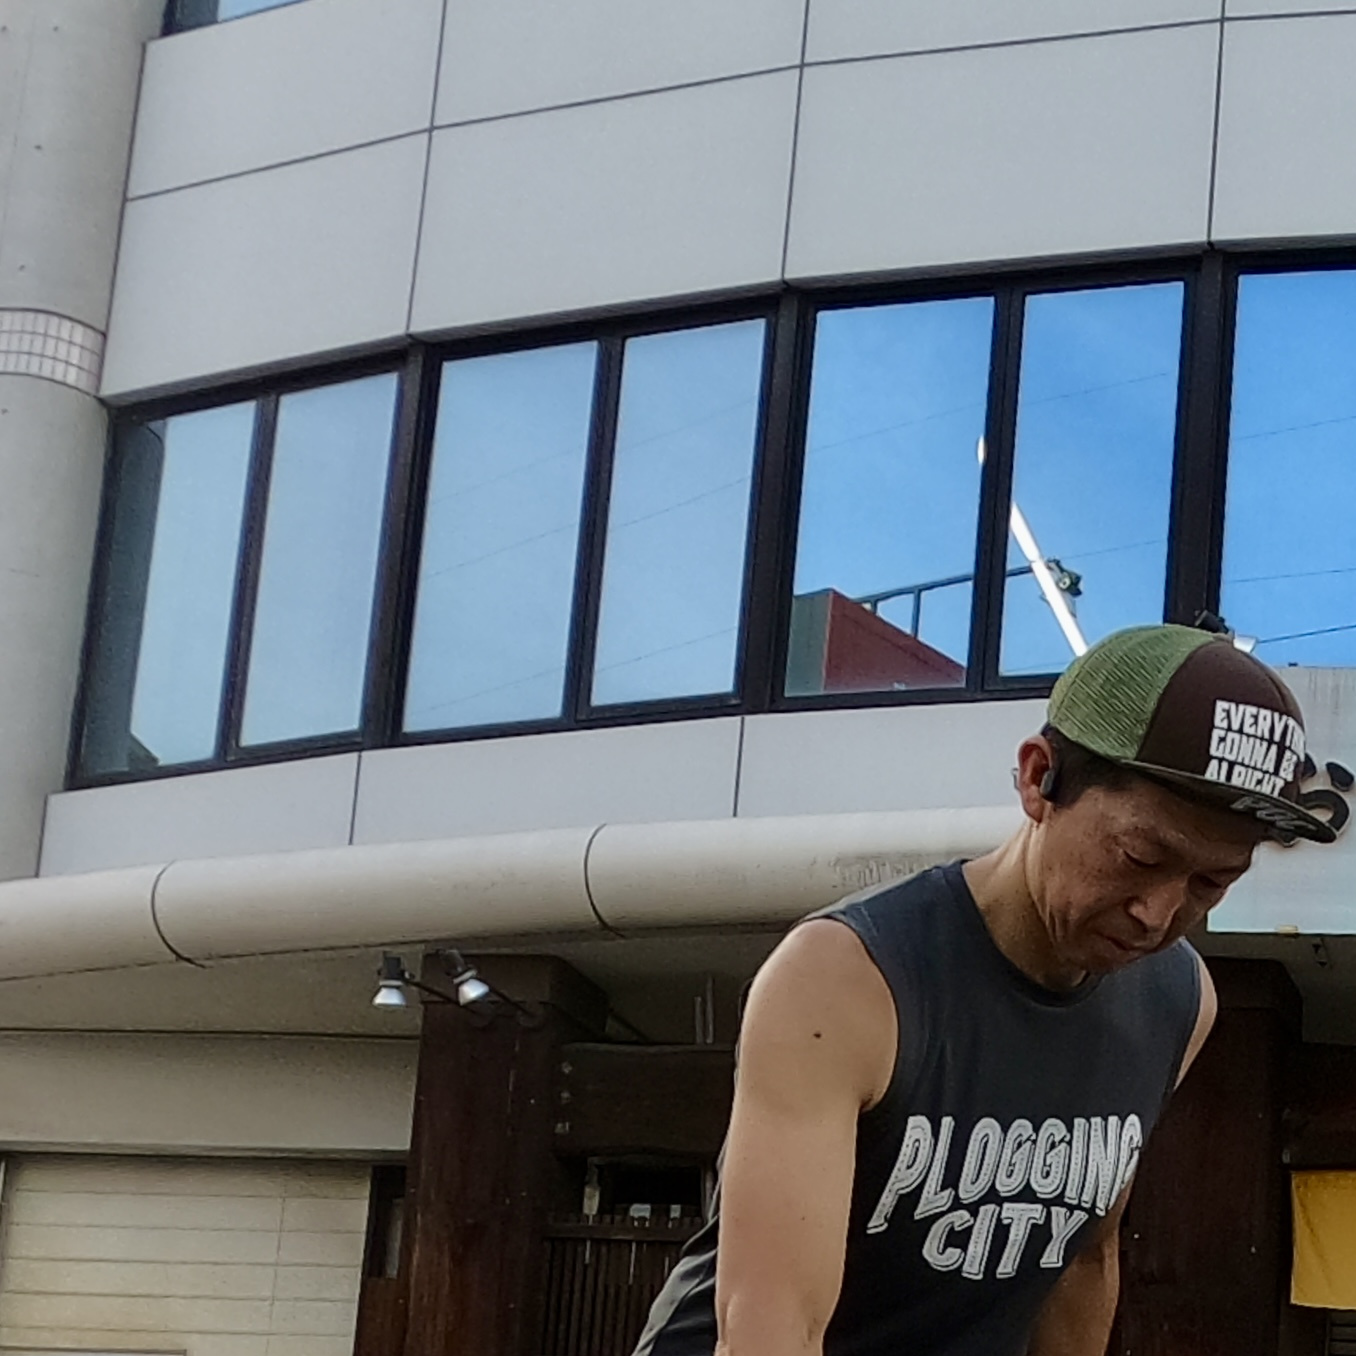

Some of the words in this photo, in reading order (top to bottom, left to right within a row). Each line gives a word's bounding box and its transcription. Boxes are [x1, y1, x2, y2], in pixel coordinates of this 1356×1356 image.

[1208, 727, 1279, 774] GONNA
[866, 1113, 1143, 1234] PLOGGING
[922, 1203, 1089, 1280] CITY
